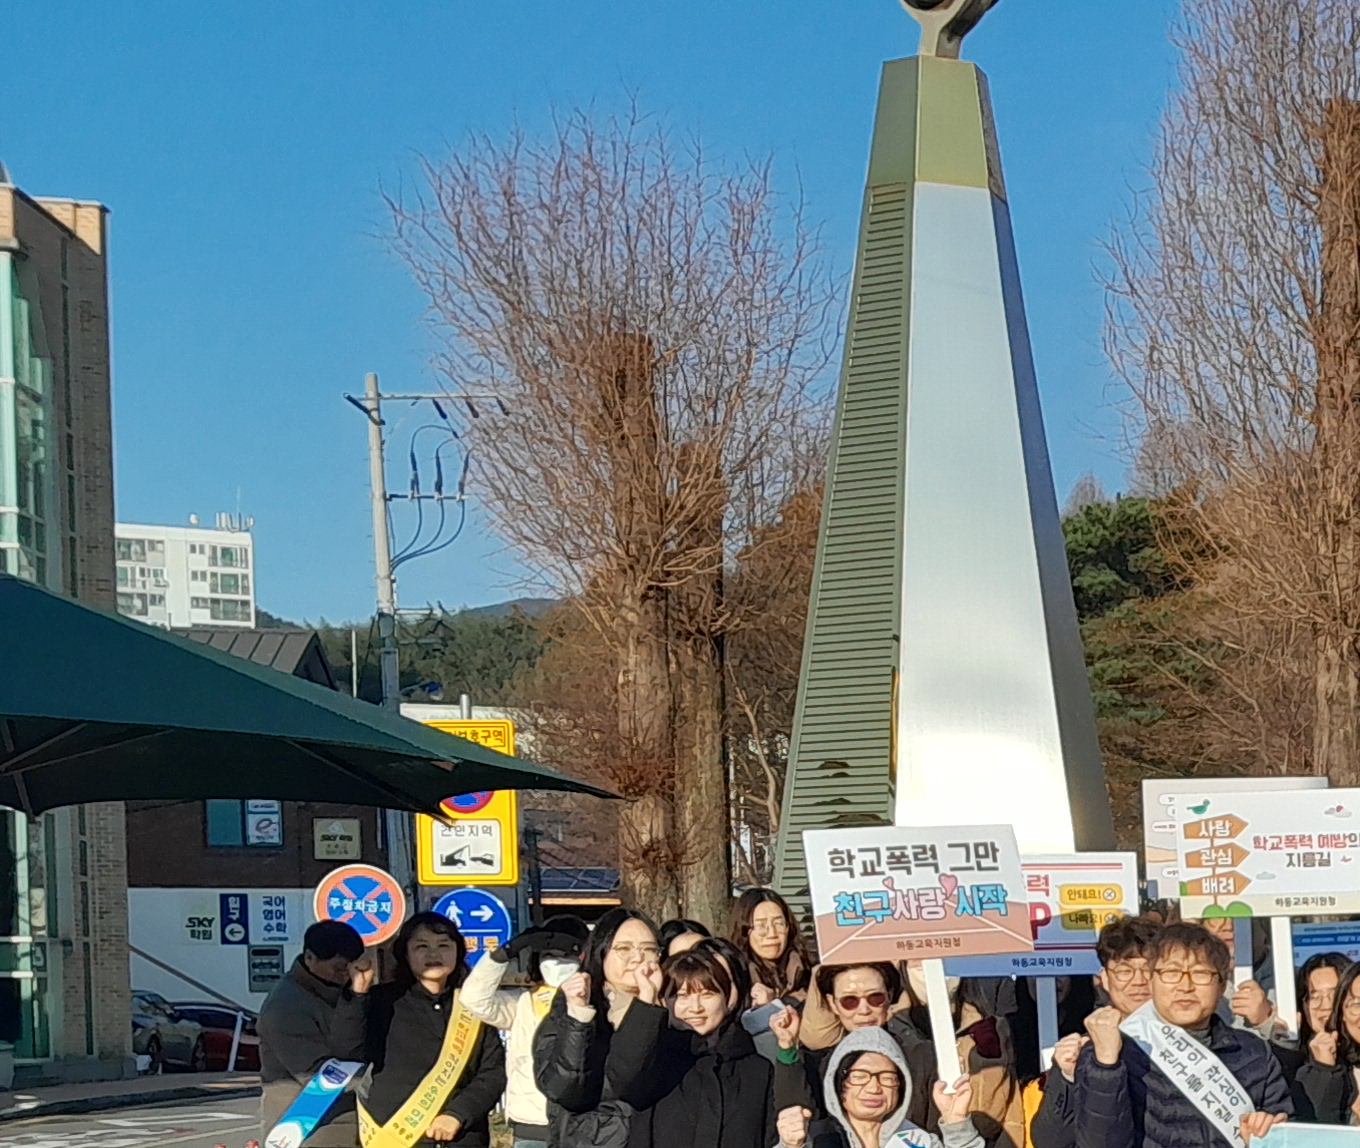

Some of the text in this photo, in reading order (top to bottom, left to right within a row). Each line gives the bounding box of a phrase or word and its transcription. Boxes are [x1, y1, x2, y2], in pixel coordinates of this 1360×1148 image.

[1199, 820, 1230, 837] 사랑
[1253, 834, 1313, 851] 학교폭력
[828, 841, 1000, 879] 학교폭력 그만
[1200, 848, 1232, 866] 관심
[1286, 851, 1331, 868] 지름길
[1202, 877, 1235, 894] 배려
[262, 896, 285, 907] 국어
[954, 883, 1008, 917] 시작
[1275, 896, 1336, 907] 하동교육지원청
[185, 917, 215, 928] SKY
[262, 909, 286, 920] 영어
[190, 929, 213, 940] 학원
[896, 937, 961, 950] 하동교육지원청
[1012, 957, 1072, 968] 하동교육지원청
[1162, 1025, 1247, 1107] 우리의 관심이
[1158, 1048, 1204, 1092] 친구를
[1200, 1090, 1234, 1123] 지킬
